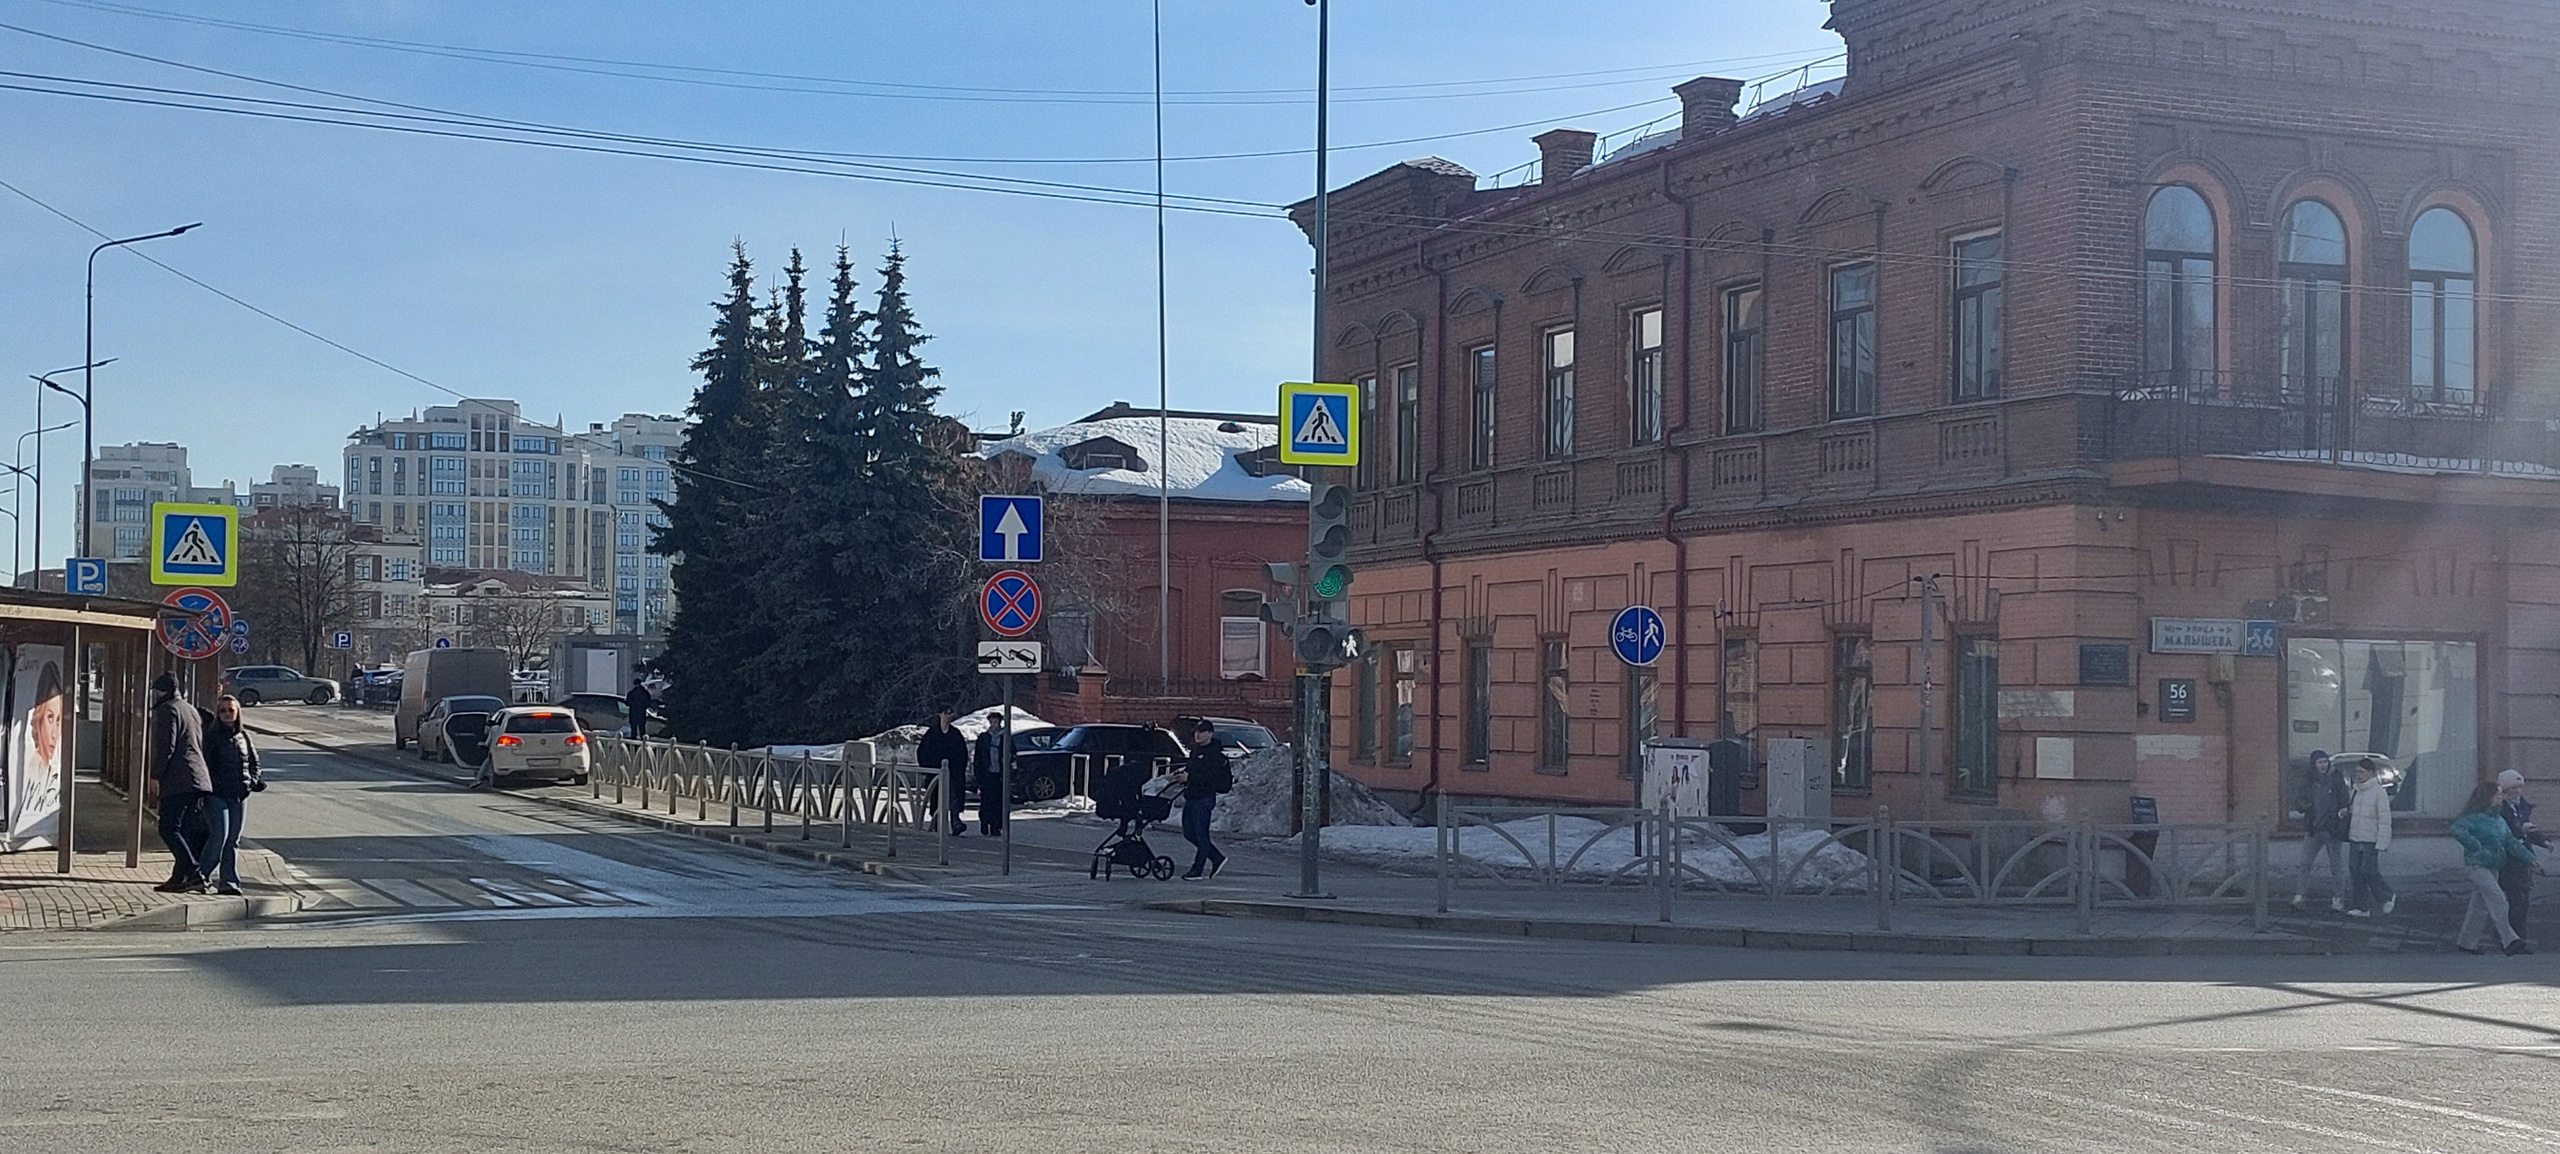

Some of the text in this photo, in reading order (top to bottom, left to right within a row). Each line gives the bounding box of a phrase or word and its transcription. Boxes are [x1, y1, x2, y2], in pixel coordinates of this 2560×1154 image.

[77, 562, 99, 591] P
[338, 634, 349, 647] P
[2164, 635, 2233, 647] МАЛЫШЕВА
[2250, 628, 2274, 649] 56
[2170, 684, 2187, 699] 56
